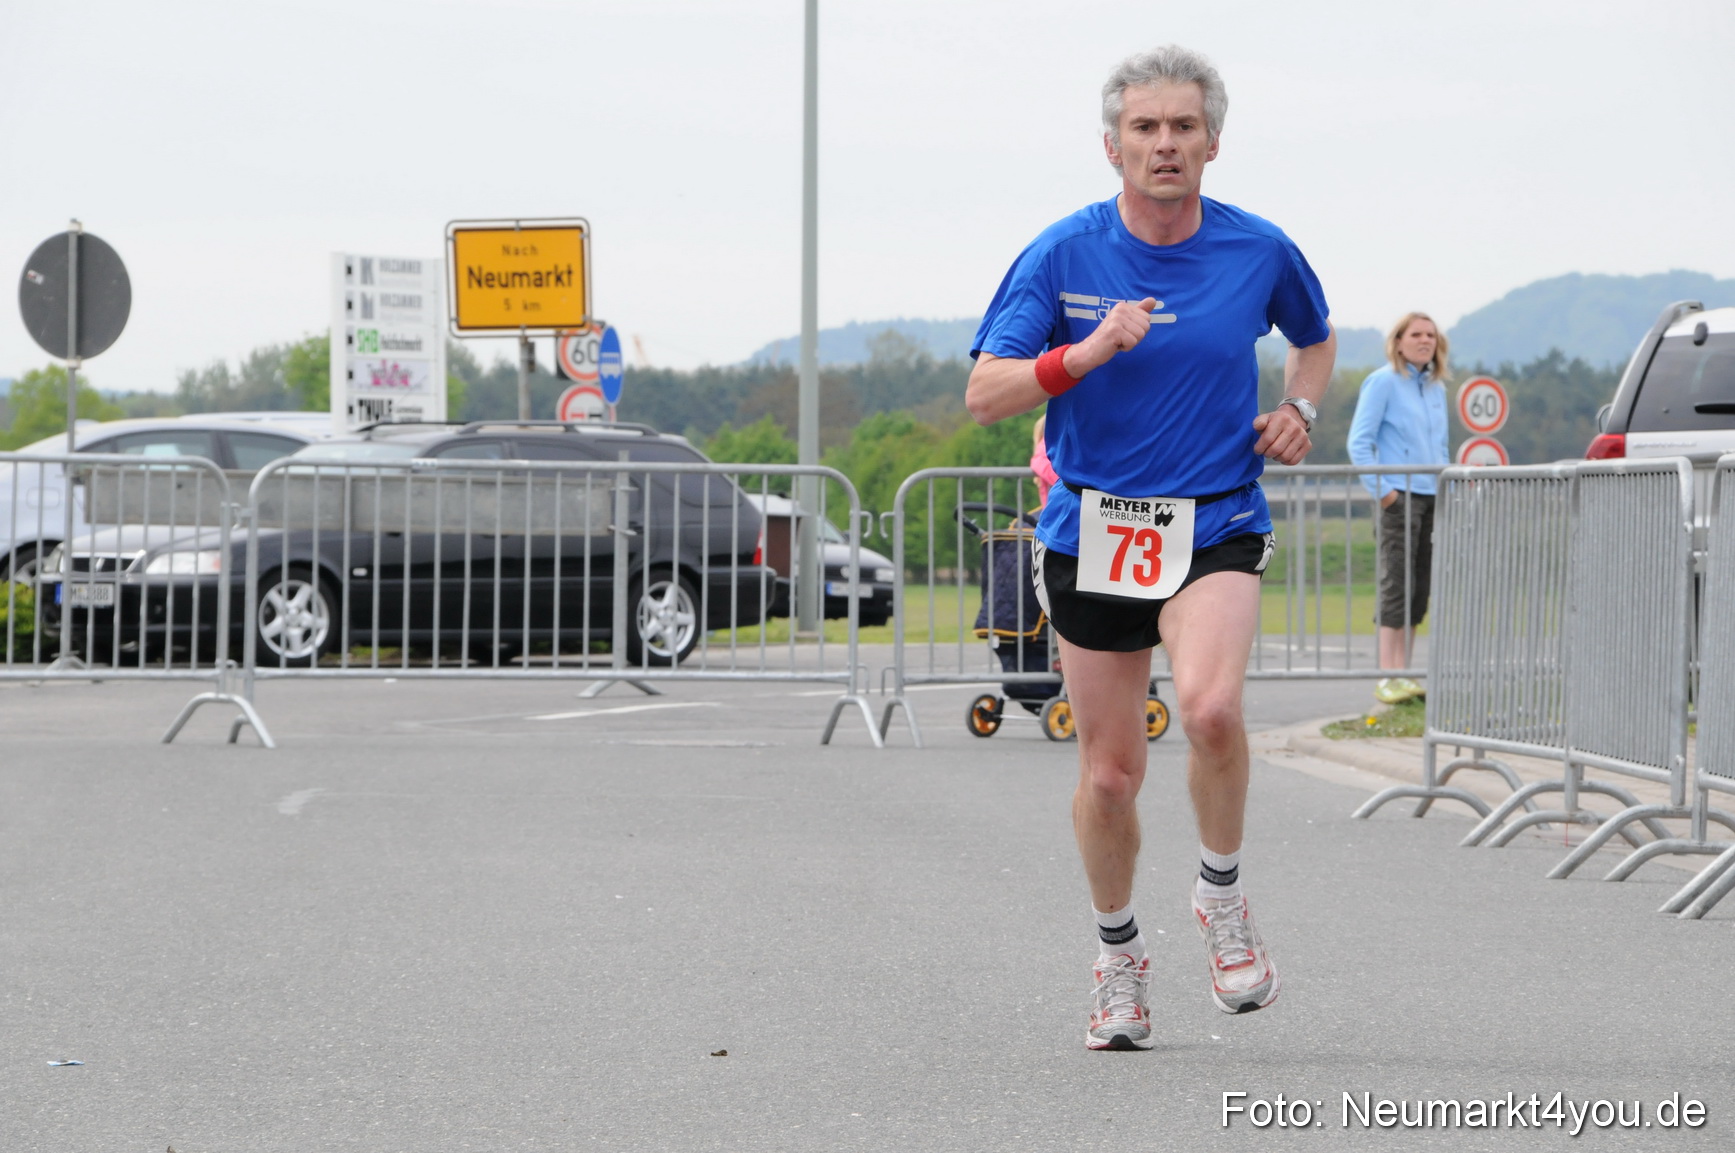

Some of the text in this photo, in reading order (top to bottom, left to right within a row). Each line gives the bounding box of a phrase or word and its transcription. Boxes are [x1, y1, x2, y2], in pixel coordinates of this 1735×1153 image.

[502, 244, 539, 256] Nach
[467, 264, 573, 289] Neumarkt
[504, 299, 542, 311] 5 km
[571, 339, 599, 365] 60
[1471, 393, 1498, 417] 60
[1100, 497, 1151, 513] MEYER
[1099, 509, 1151, 523] WERBUNG
[1106, 524, 1163, 588] 73
